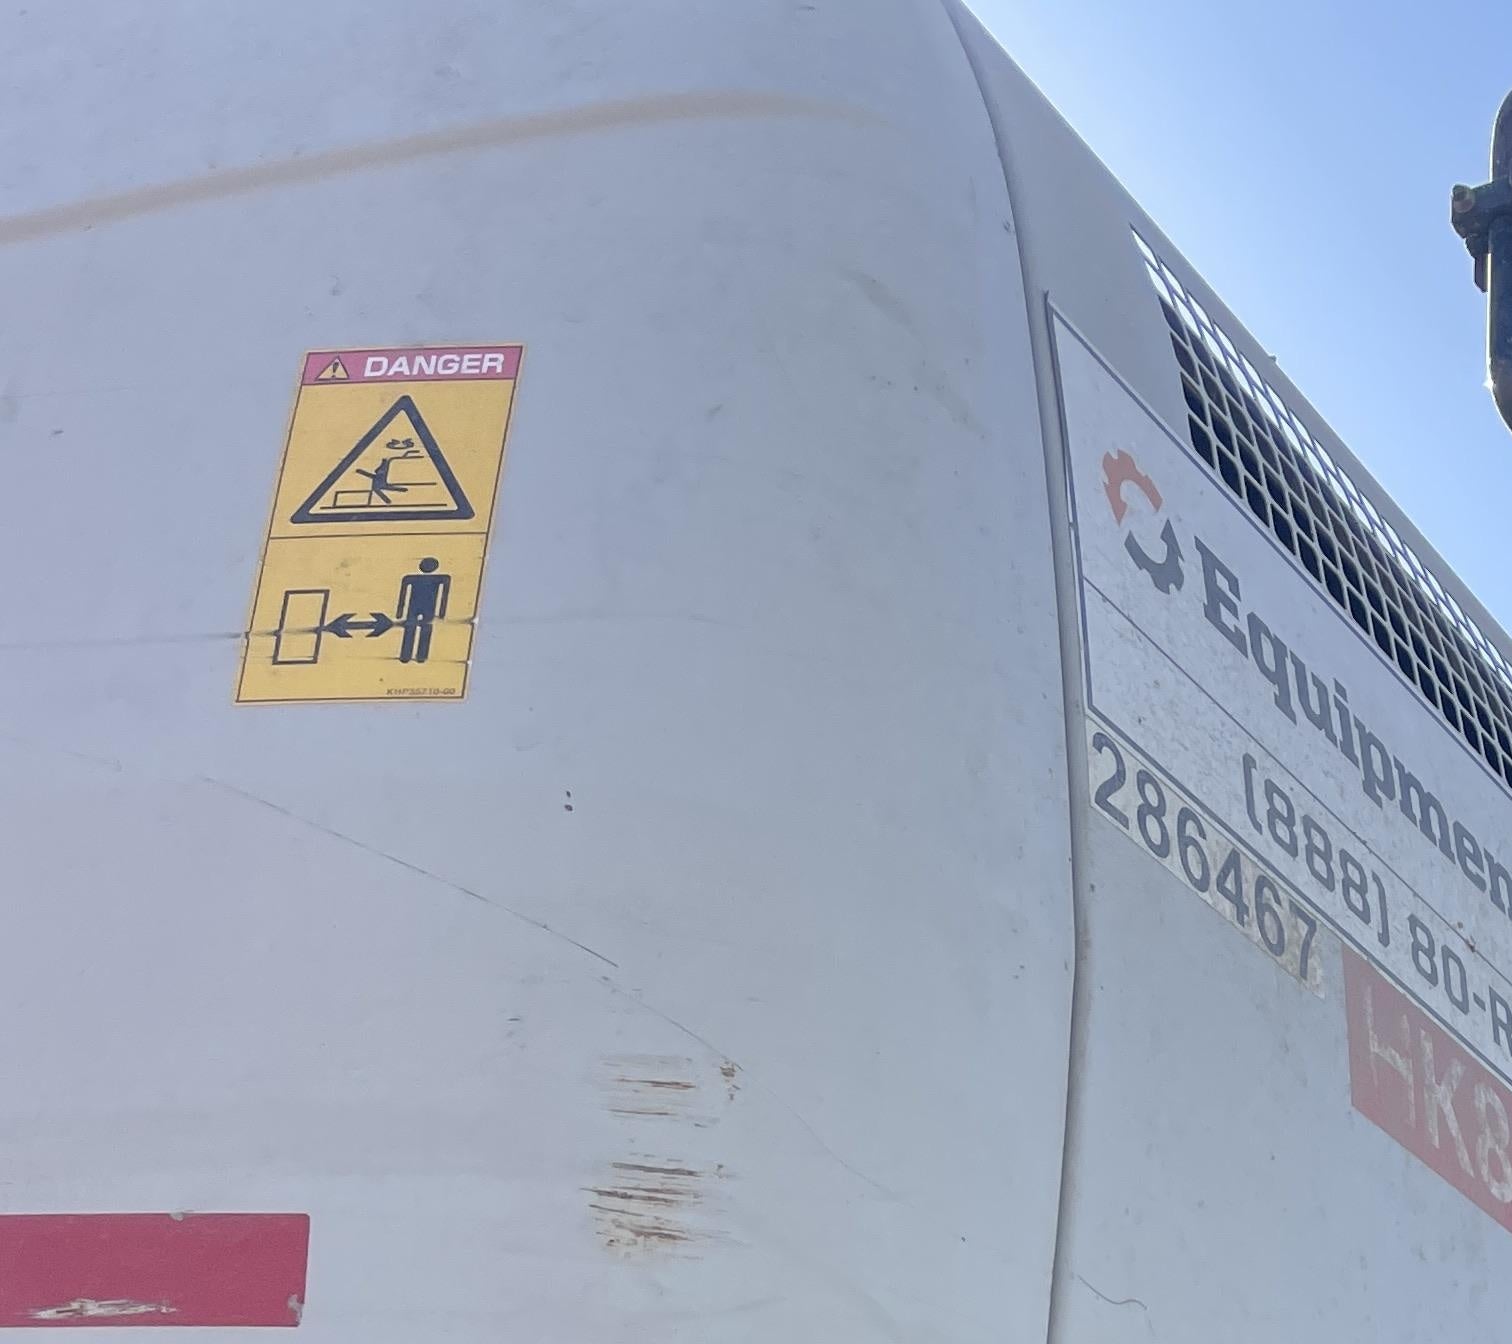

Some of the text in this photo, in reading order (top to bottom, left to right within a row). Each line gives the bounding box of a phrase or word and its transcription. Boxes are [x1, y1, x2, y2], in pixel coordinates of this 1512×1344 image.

[363, 353, 505, 378] DANGER
[1092, 731, 1317, 981] 286467
[1242, 752, 1390, 948] (888)
